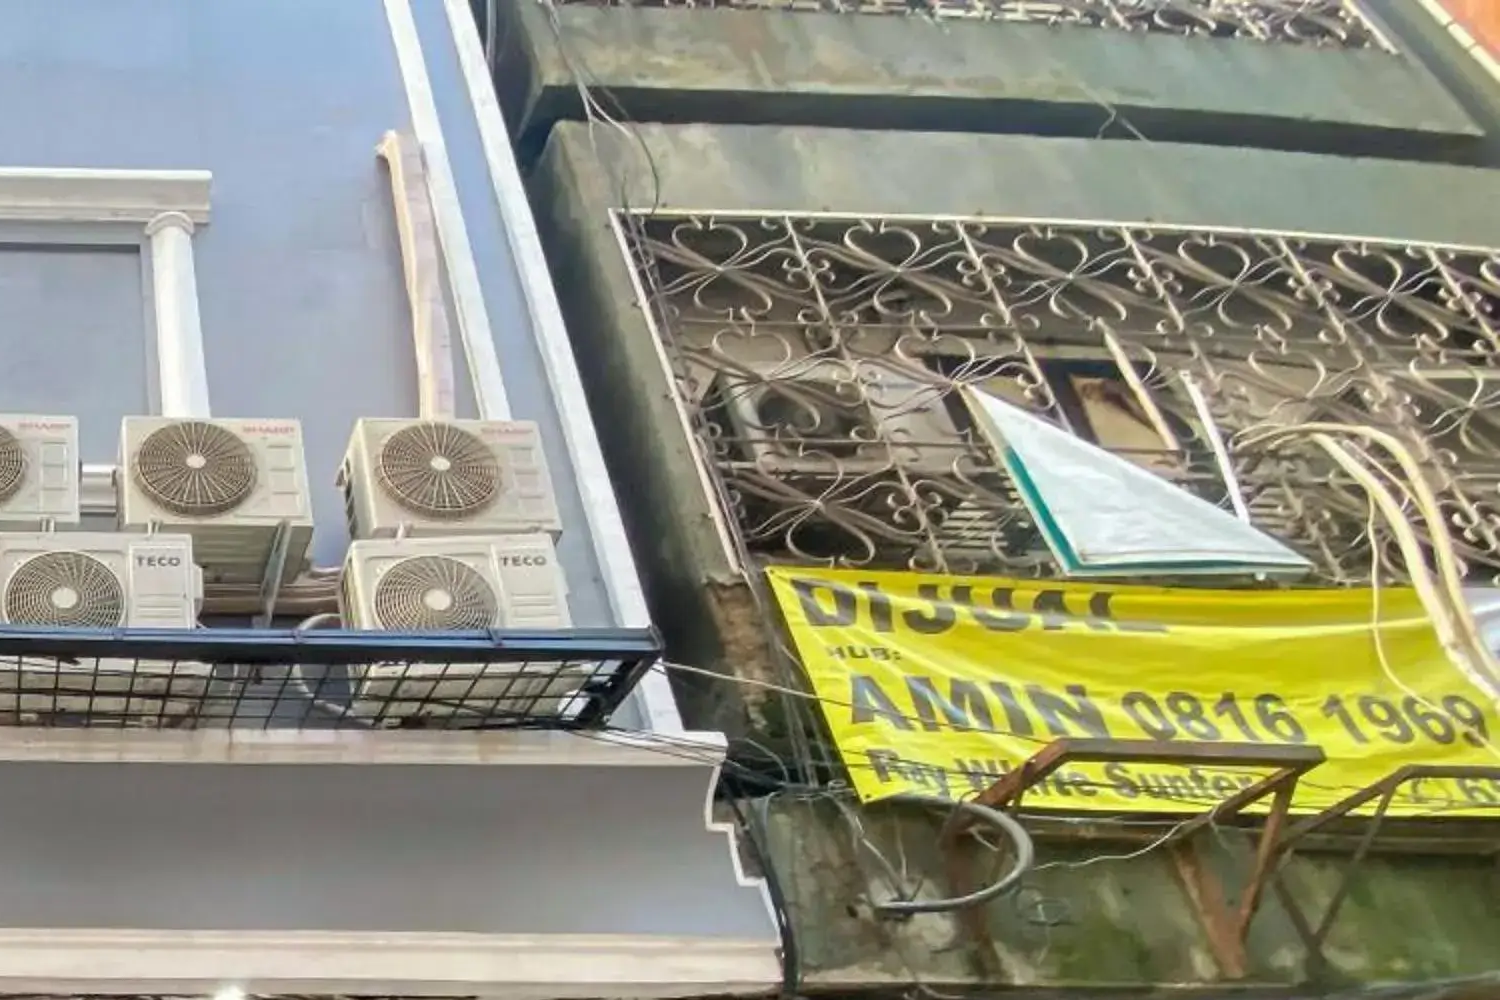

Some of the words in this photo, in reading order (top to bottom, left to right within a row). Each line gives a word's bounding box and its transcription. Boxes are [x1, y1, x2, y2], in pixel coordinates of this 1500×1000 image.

[136, 555, 181, 567] TECO
[500, 555, 547, 567] TECO
[790, 579, 1168, 635] DIJUAL
[851, 675, 1112, 739] AMIN
[1121, 691, 1307, 742] 0816
[1320, 694, 1490, 748] 1969
